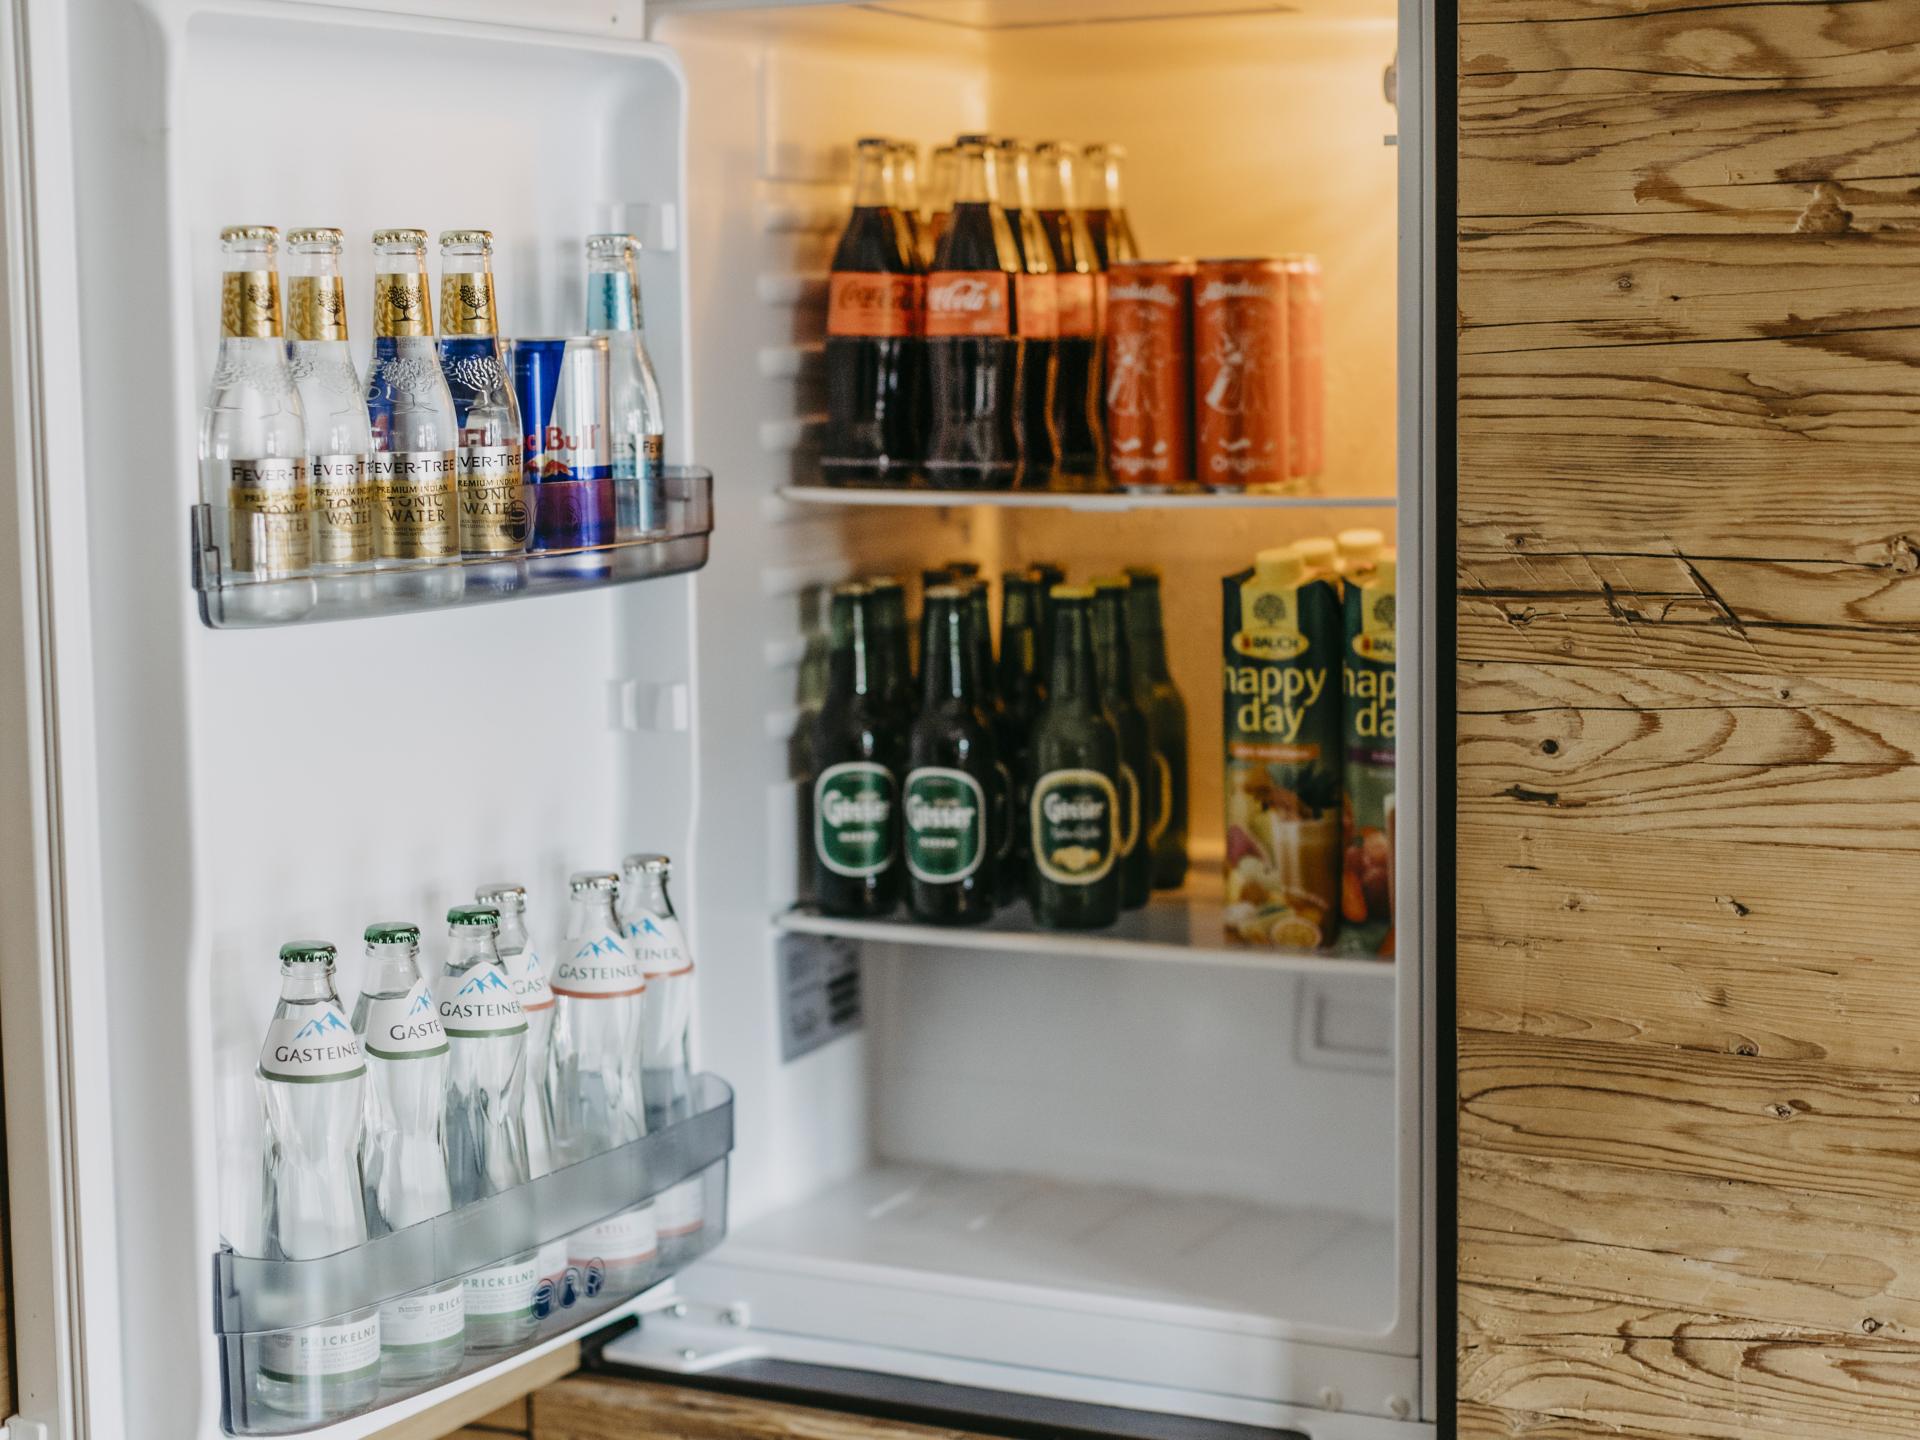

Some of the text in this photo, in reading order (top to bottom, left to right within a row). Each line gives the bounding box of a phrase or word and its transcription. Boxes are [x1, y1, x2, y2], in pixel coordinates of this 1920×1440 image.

[545, 425, 600, 451] Bull
[371, 459, 455, 474] EVER-TREE
[457, 453, 522, 468] VER-TRE
[387, 495, 444, 508] TONIC
[386, 509, 446, 523] WATER
[1343, 660, 1395, 710] hap
[1237, 696, 1305, 743] day
[1355, 699, 1395, 739] da
[558, 962, 640, 982] GASTEINER
[440, 999, 523, 1019] GASTEINER
[429, 1296, 463, 1315] PRICK
[300, 1324, 377, 1348] PICKELND
